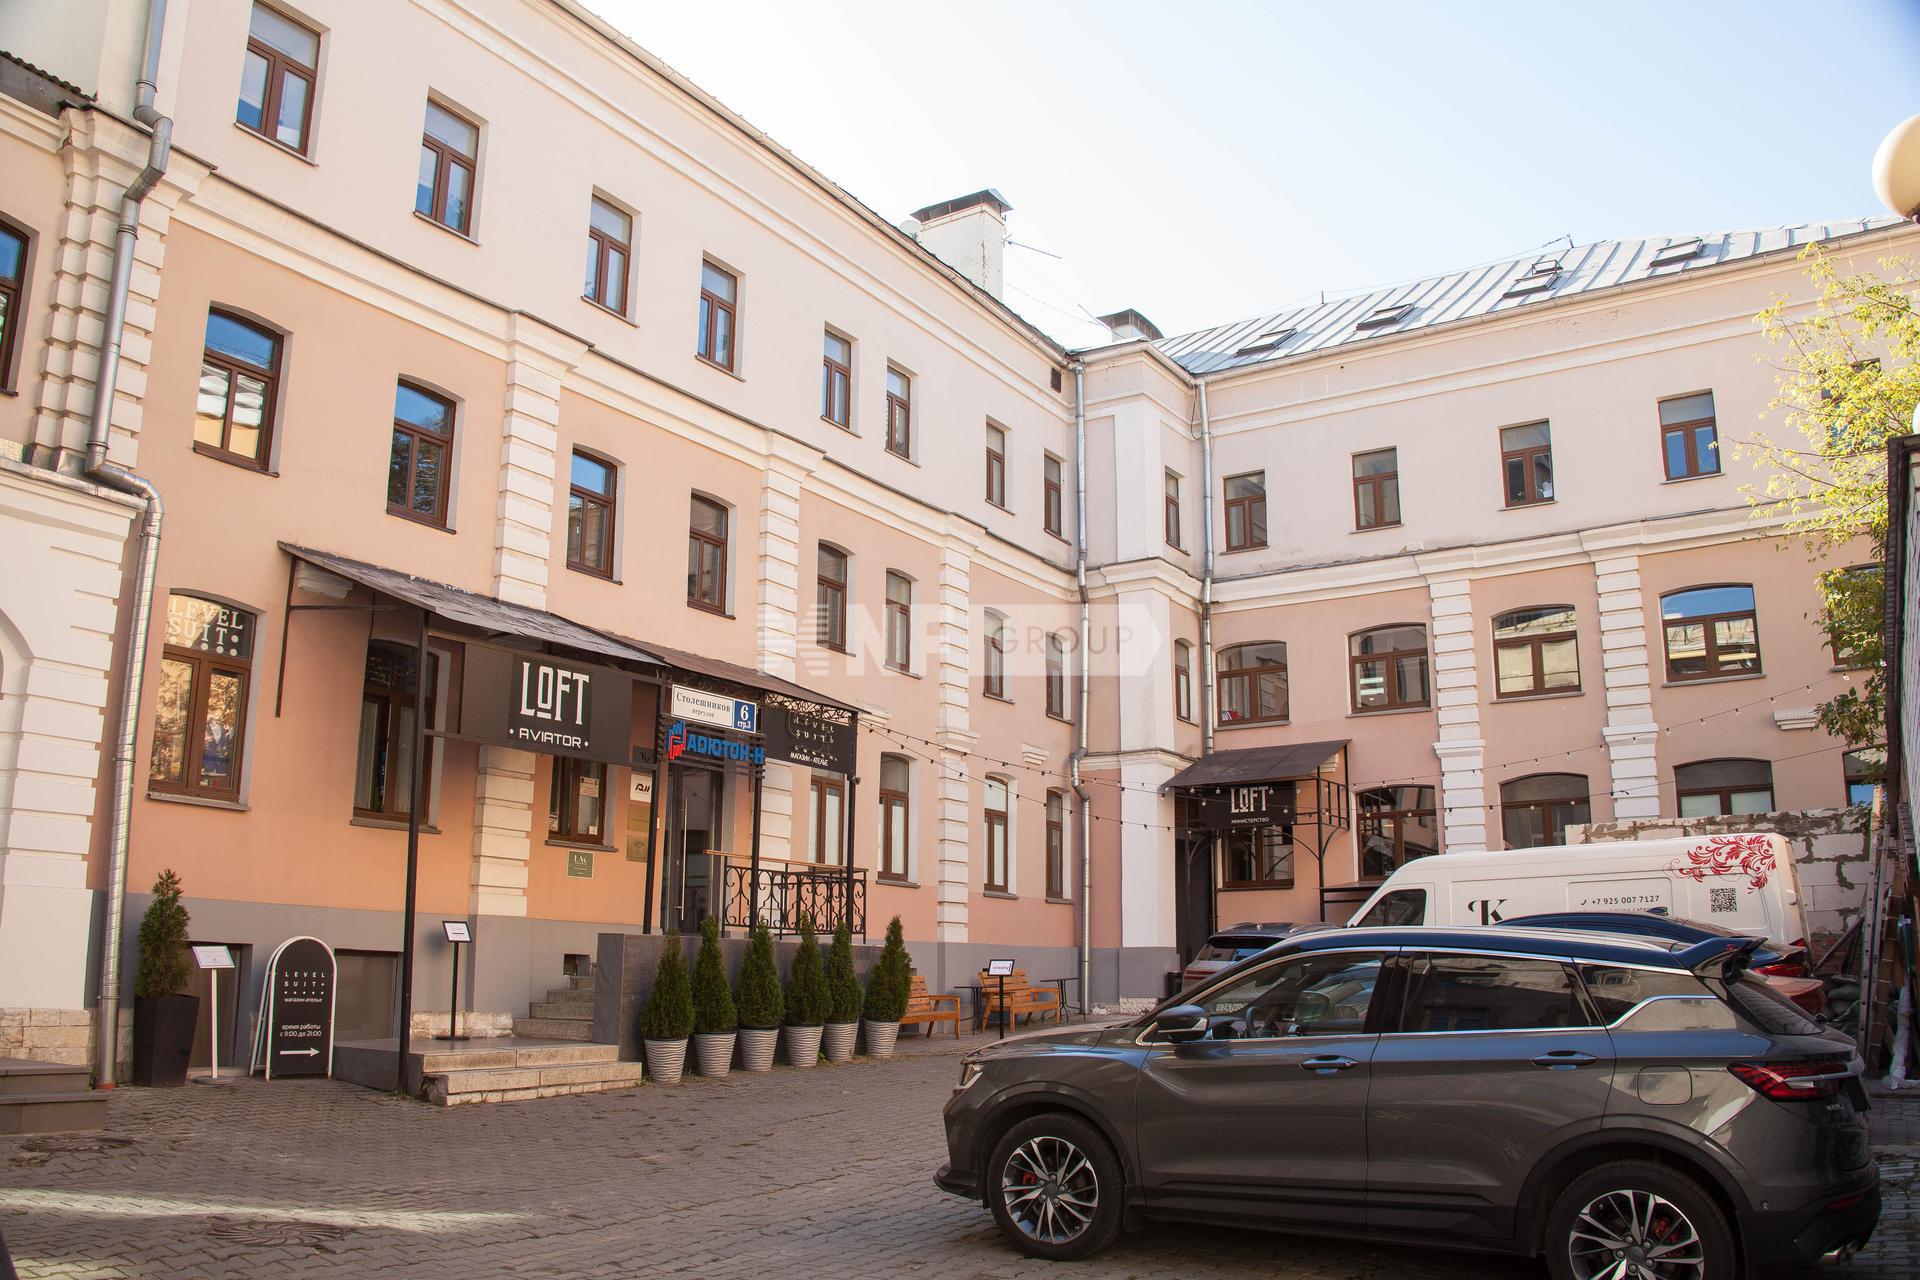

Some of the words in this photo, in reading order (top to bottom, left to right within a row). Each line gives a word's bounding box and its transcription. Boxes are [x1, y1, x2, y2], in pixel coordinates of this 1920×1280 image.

[170, 597, 244, 630] LEVEL
[167, 617, 228, 645] SUIT
[520, 661, 590, 726] LOFT
[676, 692, 731, 712] Столешников
[691, 708, 715, 718] переулок
[740, 704, 749, 721] 6
[519, 728, 582, 749] AVIATOR
[1231, 786, 1269, 813] LOFT
[1639, 895, 1660, 903] 7127
